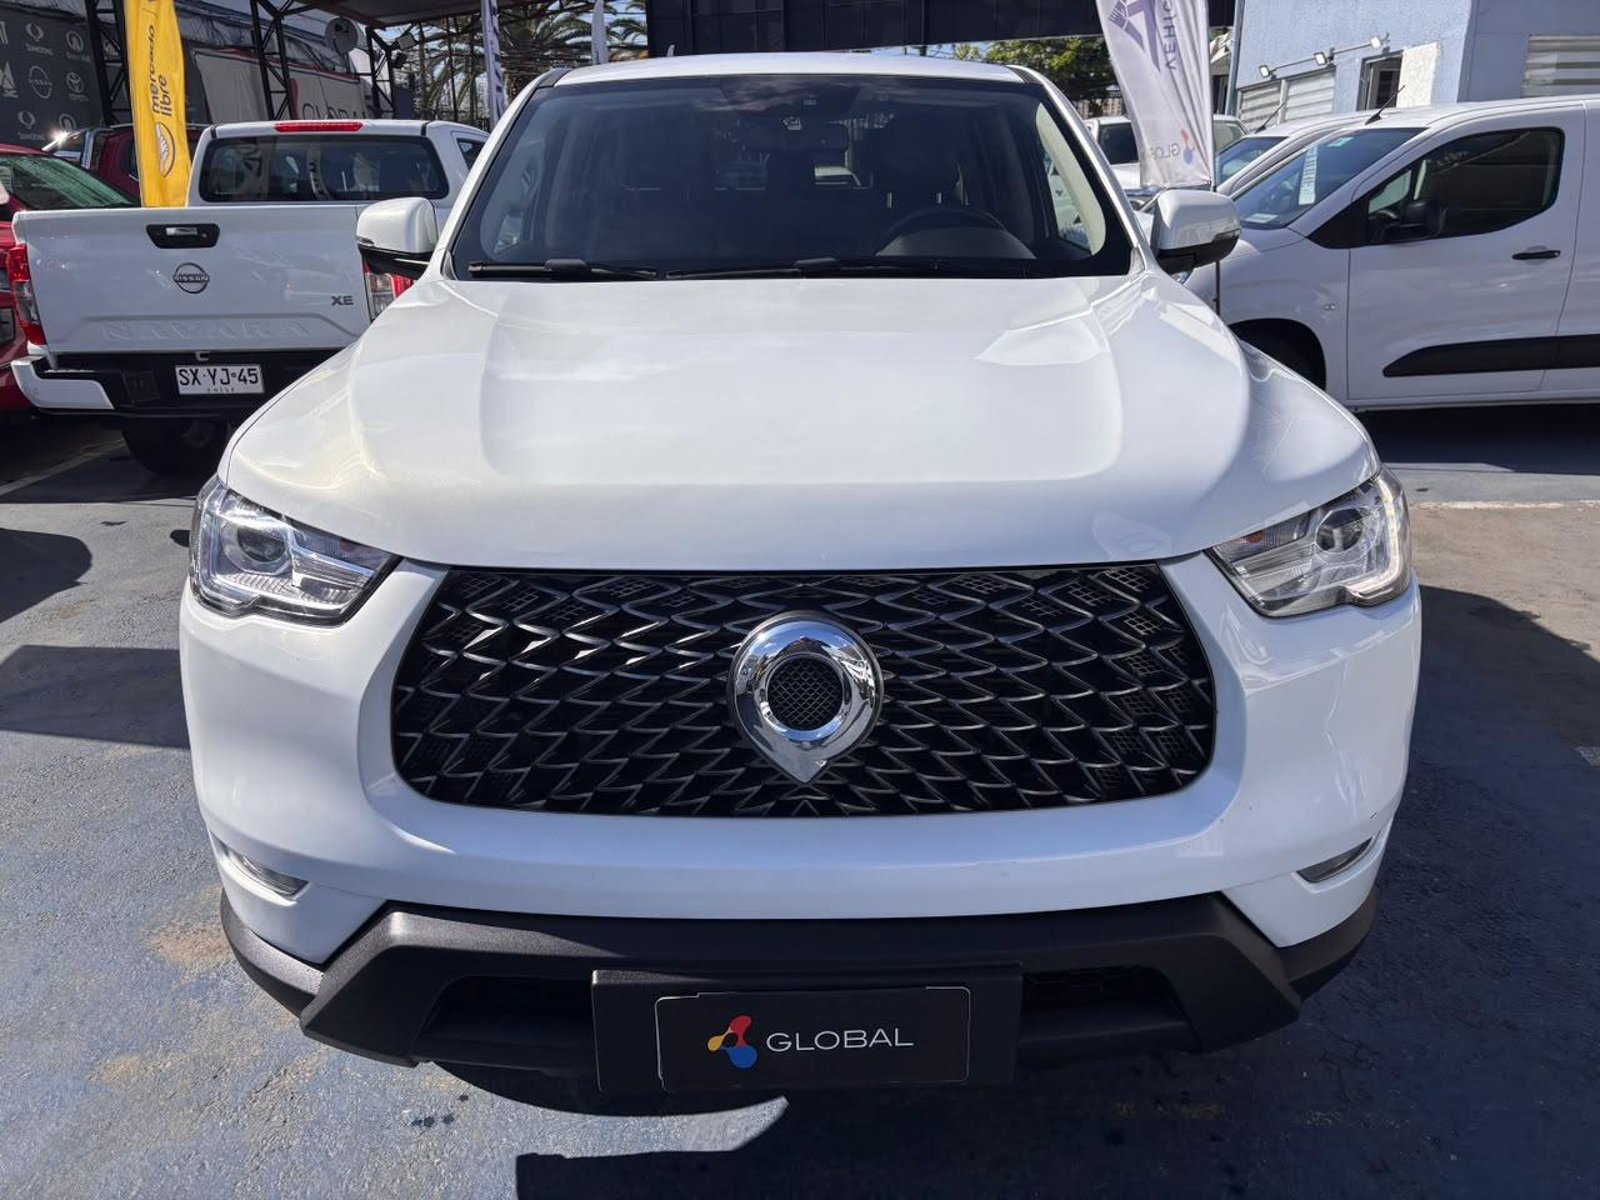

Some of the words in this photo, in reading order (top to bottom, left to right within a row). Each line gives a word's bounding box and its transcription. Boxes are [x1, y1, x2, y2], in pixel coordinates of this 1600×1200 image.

[148, 25, 160, 114] mercado
[158, 74, 172, 117] libre
[331, 295, 354, 306] XE
[766, 1028, 914, 1052] GLOBAL
